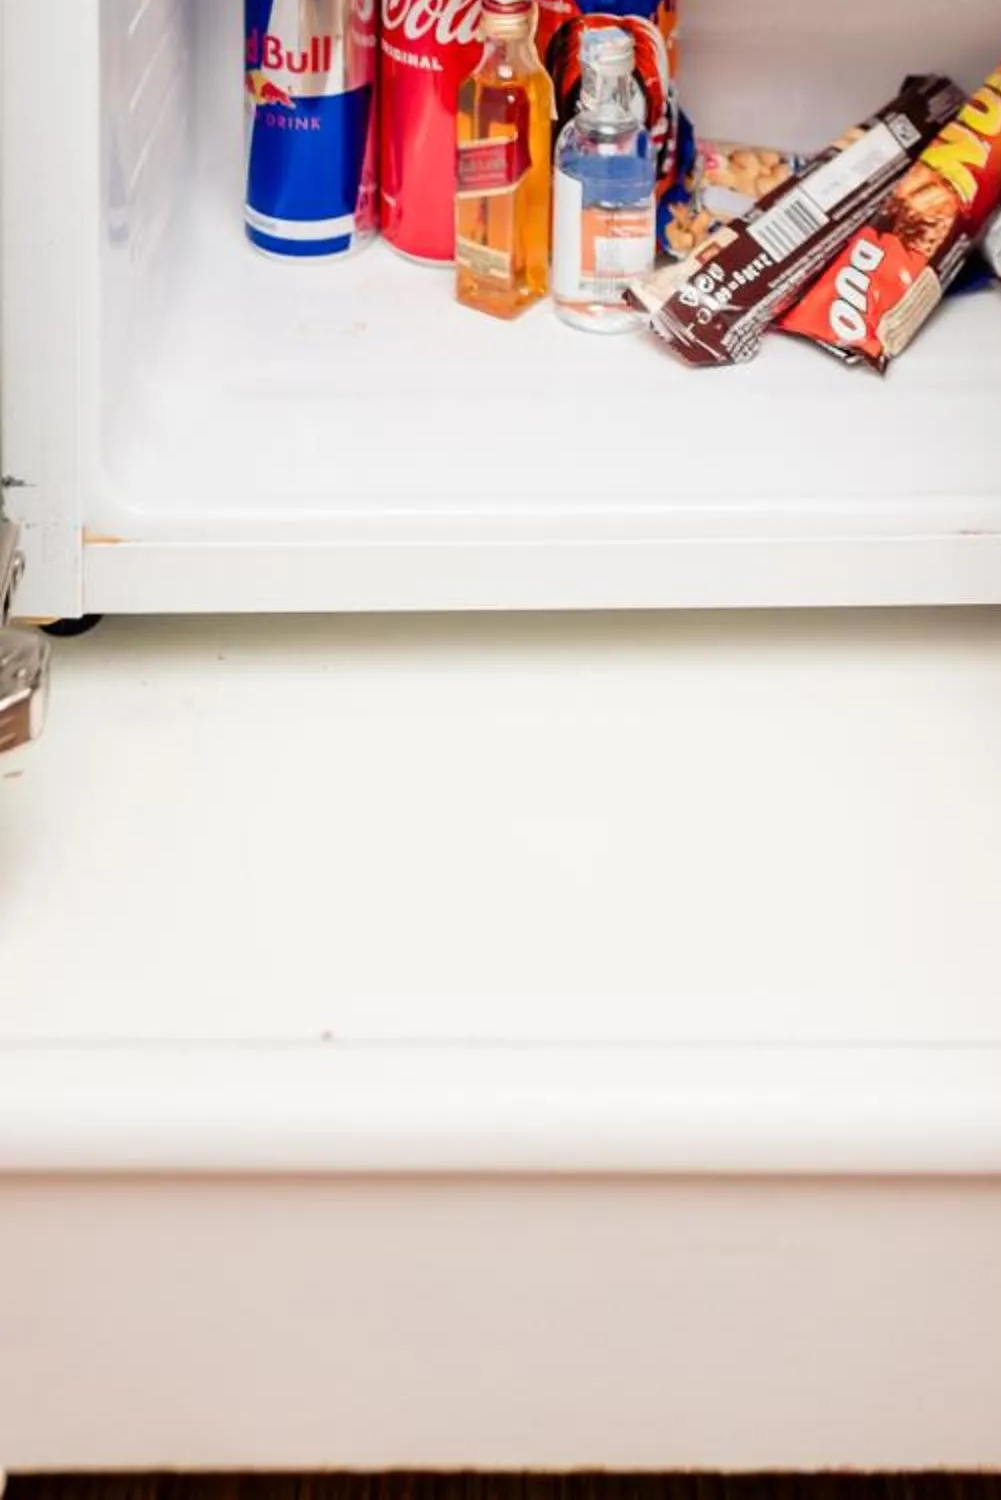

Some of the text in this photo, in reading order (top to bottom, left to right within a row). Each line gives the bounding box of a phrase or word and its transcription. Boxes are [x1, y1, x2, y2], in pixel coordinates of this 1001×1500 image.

[263, 34, 332, 74] Bull
[265, 113, 321, 131] DRINK
[829, 238, 884, 342] DUO
